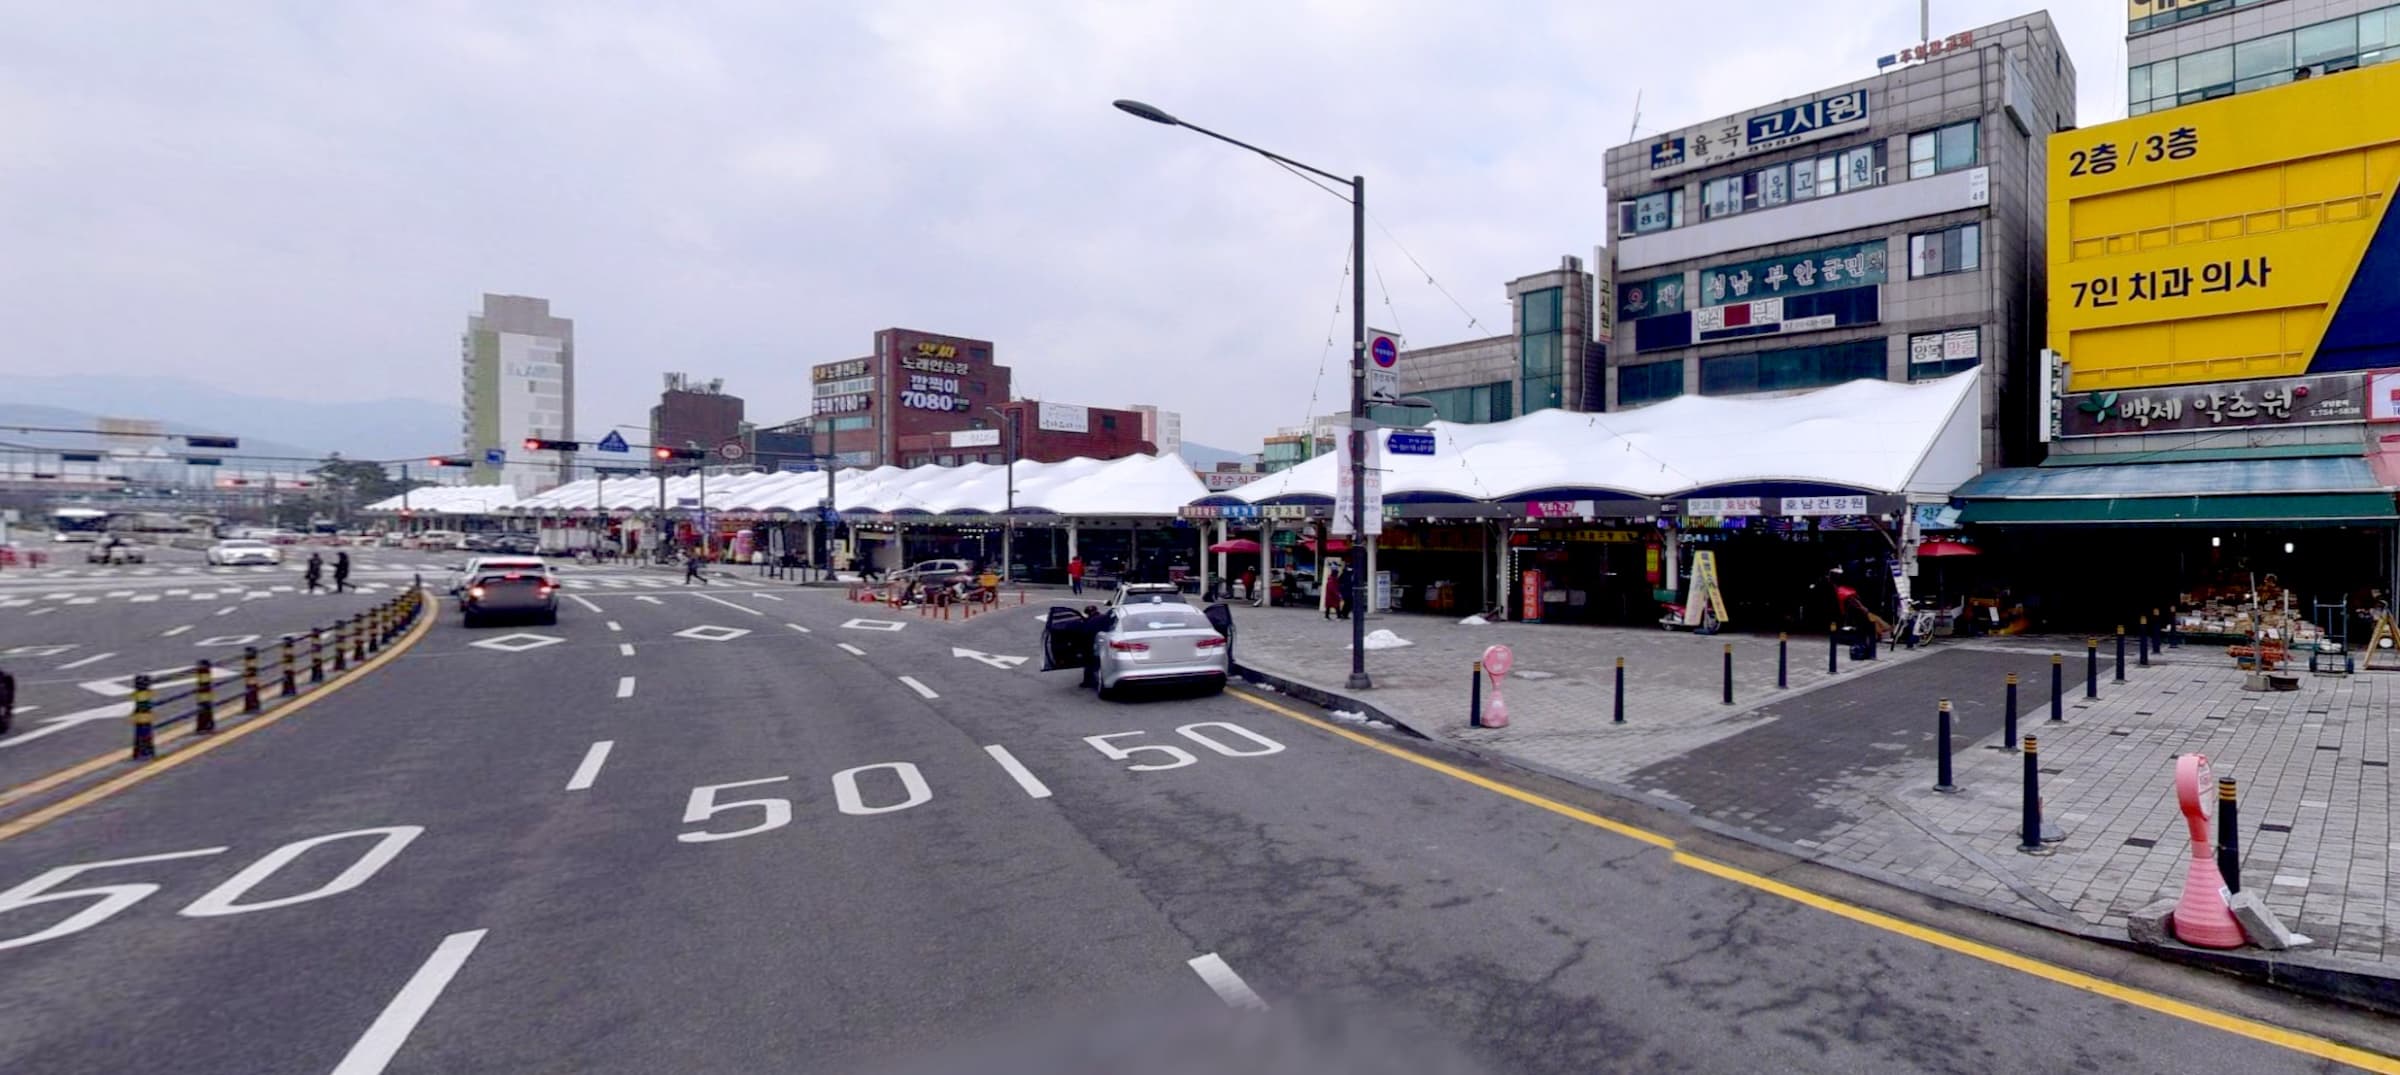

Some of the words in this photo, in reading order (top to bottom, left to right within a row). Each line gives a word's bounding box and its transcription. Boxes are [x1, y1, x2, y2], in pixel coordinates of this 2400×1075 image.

[1690, 125, 1742, 157] 율곡
[1750, 91, 1864, 142] 고시원
[2069, 142, 2118, 177] 2층
[2127, 141, 2138, 166] /
[2145, 127, 2199, 162] 3층
[1707, 270, 1753, 300] 성남
[2071, 276, 2119, 308] 7인
[2129, 266, 2193, 301] 치과
[2201, 256, 2271, 294] 의사
[902, 356, 968, 375] 노래연습장
[911, 374, 959, 394] 깜찍이
[901, 391, 953, 411] 7080
[2121, 396, 2183, 427] 백제
[2193, 387, 2293, 424] 약초원
[1784, 497, 1865, 511] 호남건강원
[1083, 721, 1287, 771] 50
[676, 761, 933, 843] 50
[0, 825, 425, 950] 50
